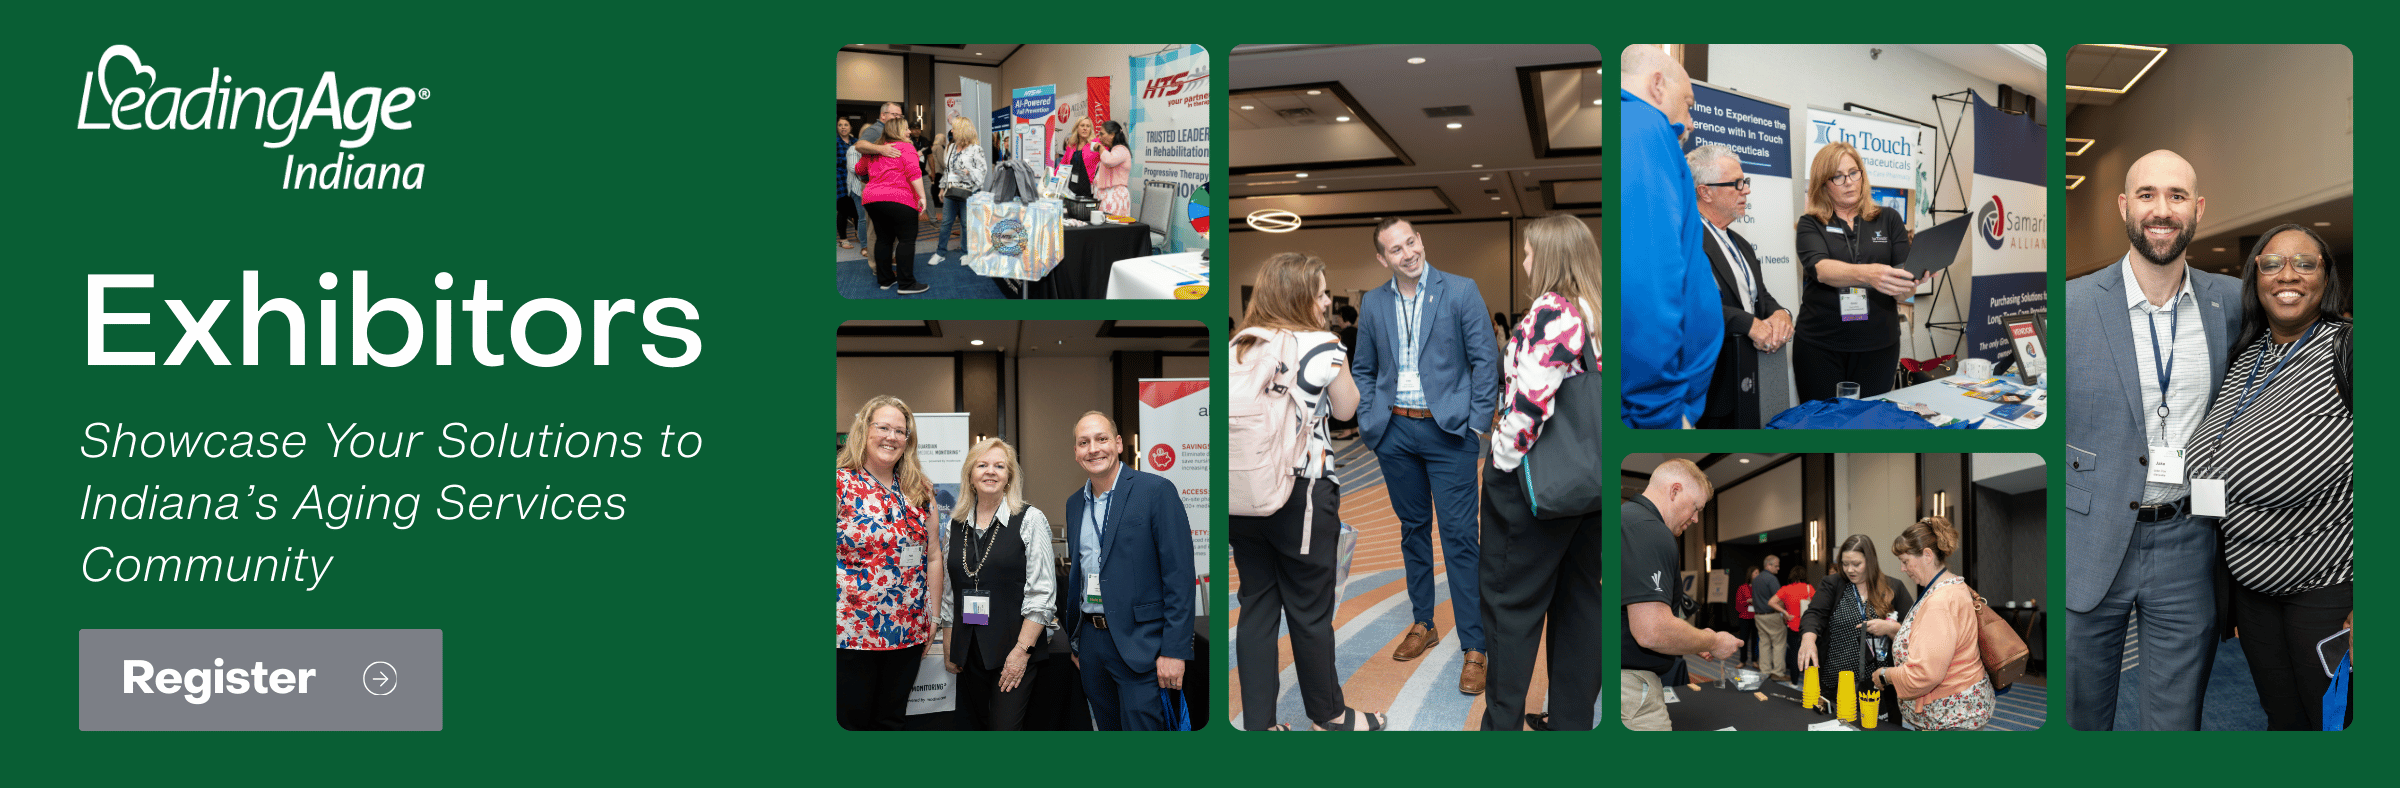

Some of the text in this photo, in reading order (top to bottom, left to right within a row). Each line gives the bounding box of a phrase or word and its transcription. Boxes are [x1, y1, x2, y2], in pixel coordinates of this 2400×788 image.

[1142, 70, 1189, 99] HTS
[1015, 97, 1052, 108] AI-Powered
[1168, 99, 1183, 107] your
[1690, 101, 1786, 131] ime to Experience the
[1146, 130, 1176, 143] TRUSTED
[1691, 118, 1783, 144] erence with In Touch
[1859, 131, 1911, 157] Touch
[1145, 145, 1210, 158] in Rehabilitation
[1862, 157, 1911, 171] maceuticals
[1144, 168, 1209, 183] Progressive Therapy
[1743, 215, 1755, 223] On
[1766, 255, 1790, 264] Needs
[1990, 294, 2020, 308] Purchasing
[2021, 291, 2043, 303] Solutions
